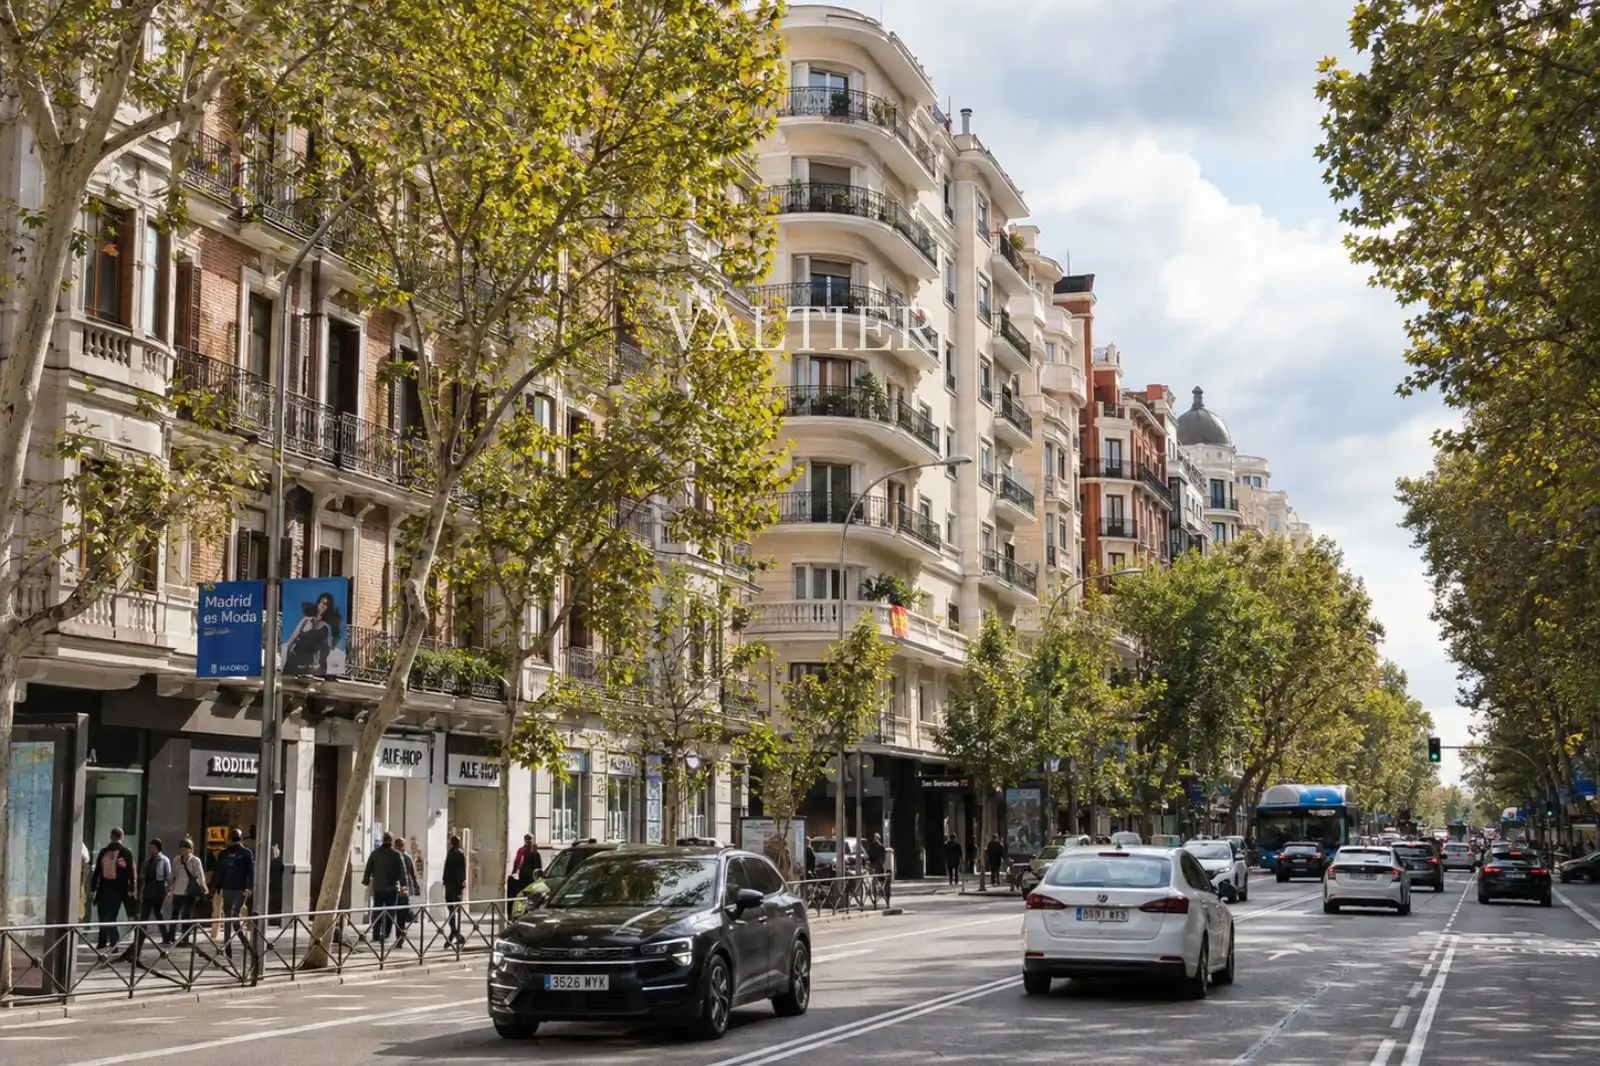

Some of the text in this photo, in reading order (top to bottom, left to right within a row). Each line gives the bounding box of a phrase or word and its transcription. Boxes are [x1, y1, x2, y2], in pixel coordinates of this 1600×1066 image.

[205, 593, 252, 608] Madrid
[203, 610, 257, 625] es Moda
[219, 663, 249, 672] MADRID
[213, 755, 259, 774] RODILL
[552, 976, 581, 989] 3526
